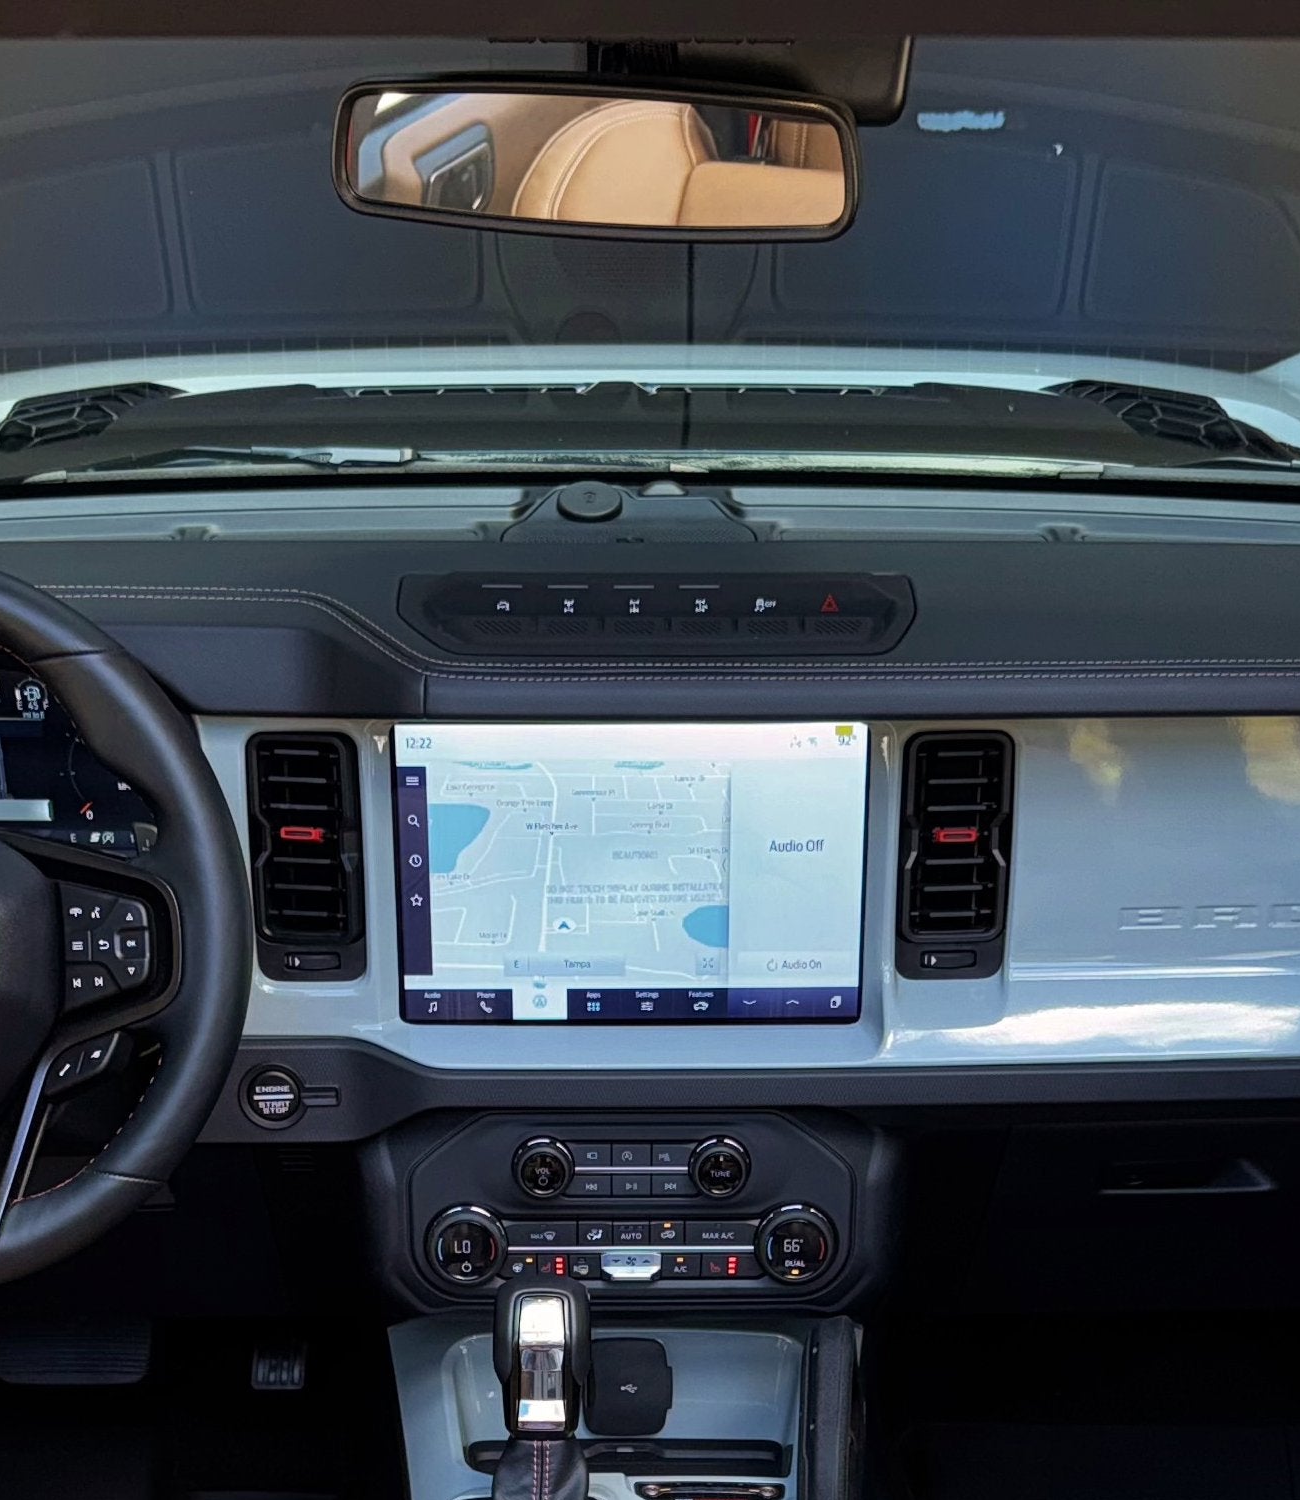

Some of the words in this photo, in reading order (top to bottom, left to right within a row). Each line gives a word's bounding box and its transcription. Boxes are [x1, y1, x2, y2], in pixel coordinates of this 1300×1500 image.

[16, 701, 23, 710] E
[405, 738, 432, 749] 12:22
[86, 810, 94, 820] 0
[534, 822, 563, 830] Fletcher
[564, 822, 578, 830] Ave
[769, 840, 803, 853] Audio
[805, 839, 825, 852] Off
[564, 959, 591, 970] Tampa
[782, 960, 807, 969] Audio
[809, 960, 822, 969] On
[586, 992, 601, 1000] Apps
[635, 991, 660, 1000] Settings
[688, 991, 714, 999] Features
[255, 1085, 290, 1093] ENGINE
[263, 1107, 289, 1115] STOP
[535, 1167, 550, 1175] VOL
[710, 1170, 731, 1178] TUNE
[621, 1232, 642, 1240] AUTO
[702, 1232, 719, 1240] MAX
[721, 1232, 735, 1240] A/C
[454, 1240, 471, 1254] LO
[783, 1238, 804, 1253] 66°
[784, 1260, 805, 1268] DUAL
[673, 1265, 688, 1273] A/C
